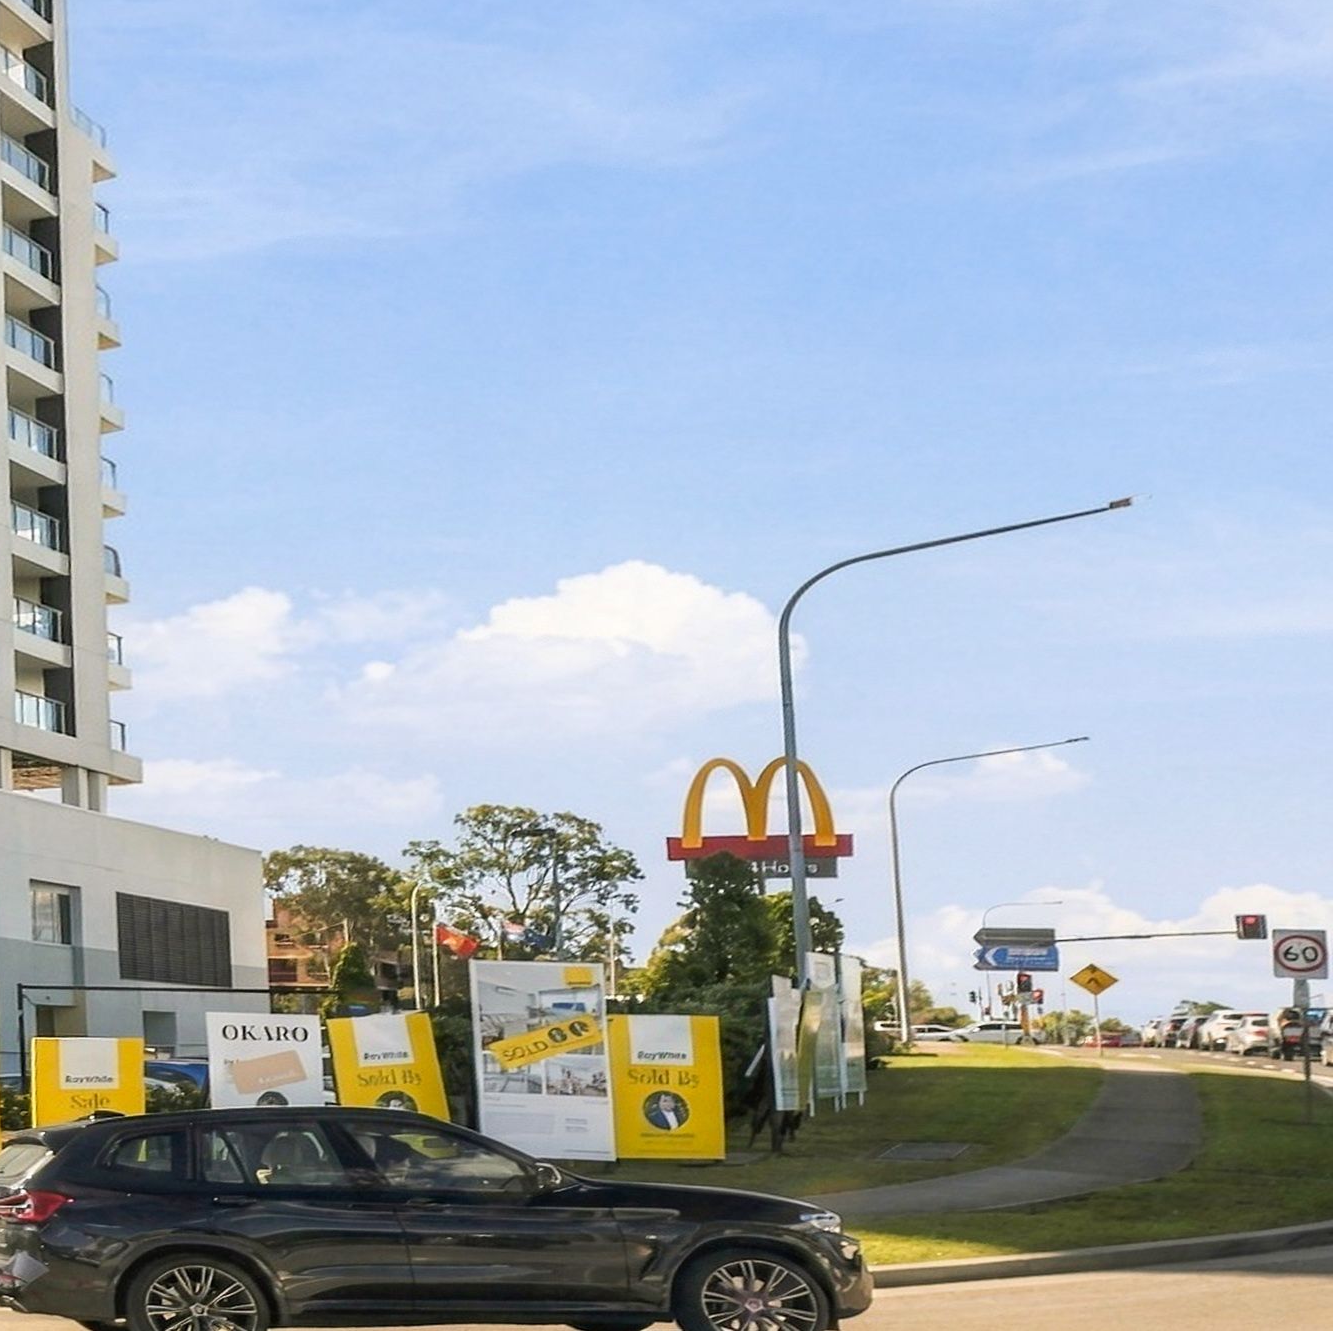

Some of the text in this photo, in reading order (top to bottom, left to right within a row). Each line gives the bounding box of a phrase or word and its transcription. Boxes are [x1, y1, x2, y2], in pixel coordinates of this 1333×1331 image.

[761, 860, 818, 874] Hos
[1283, 945, 1318, 963] 60
[221, 1024, 308, 1042] OKARO
[501, 1039, 549, 1062] SOLD
[627, 1068, 670, 1085] Sold
